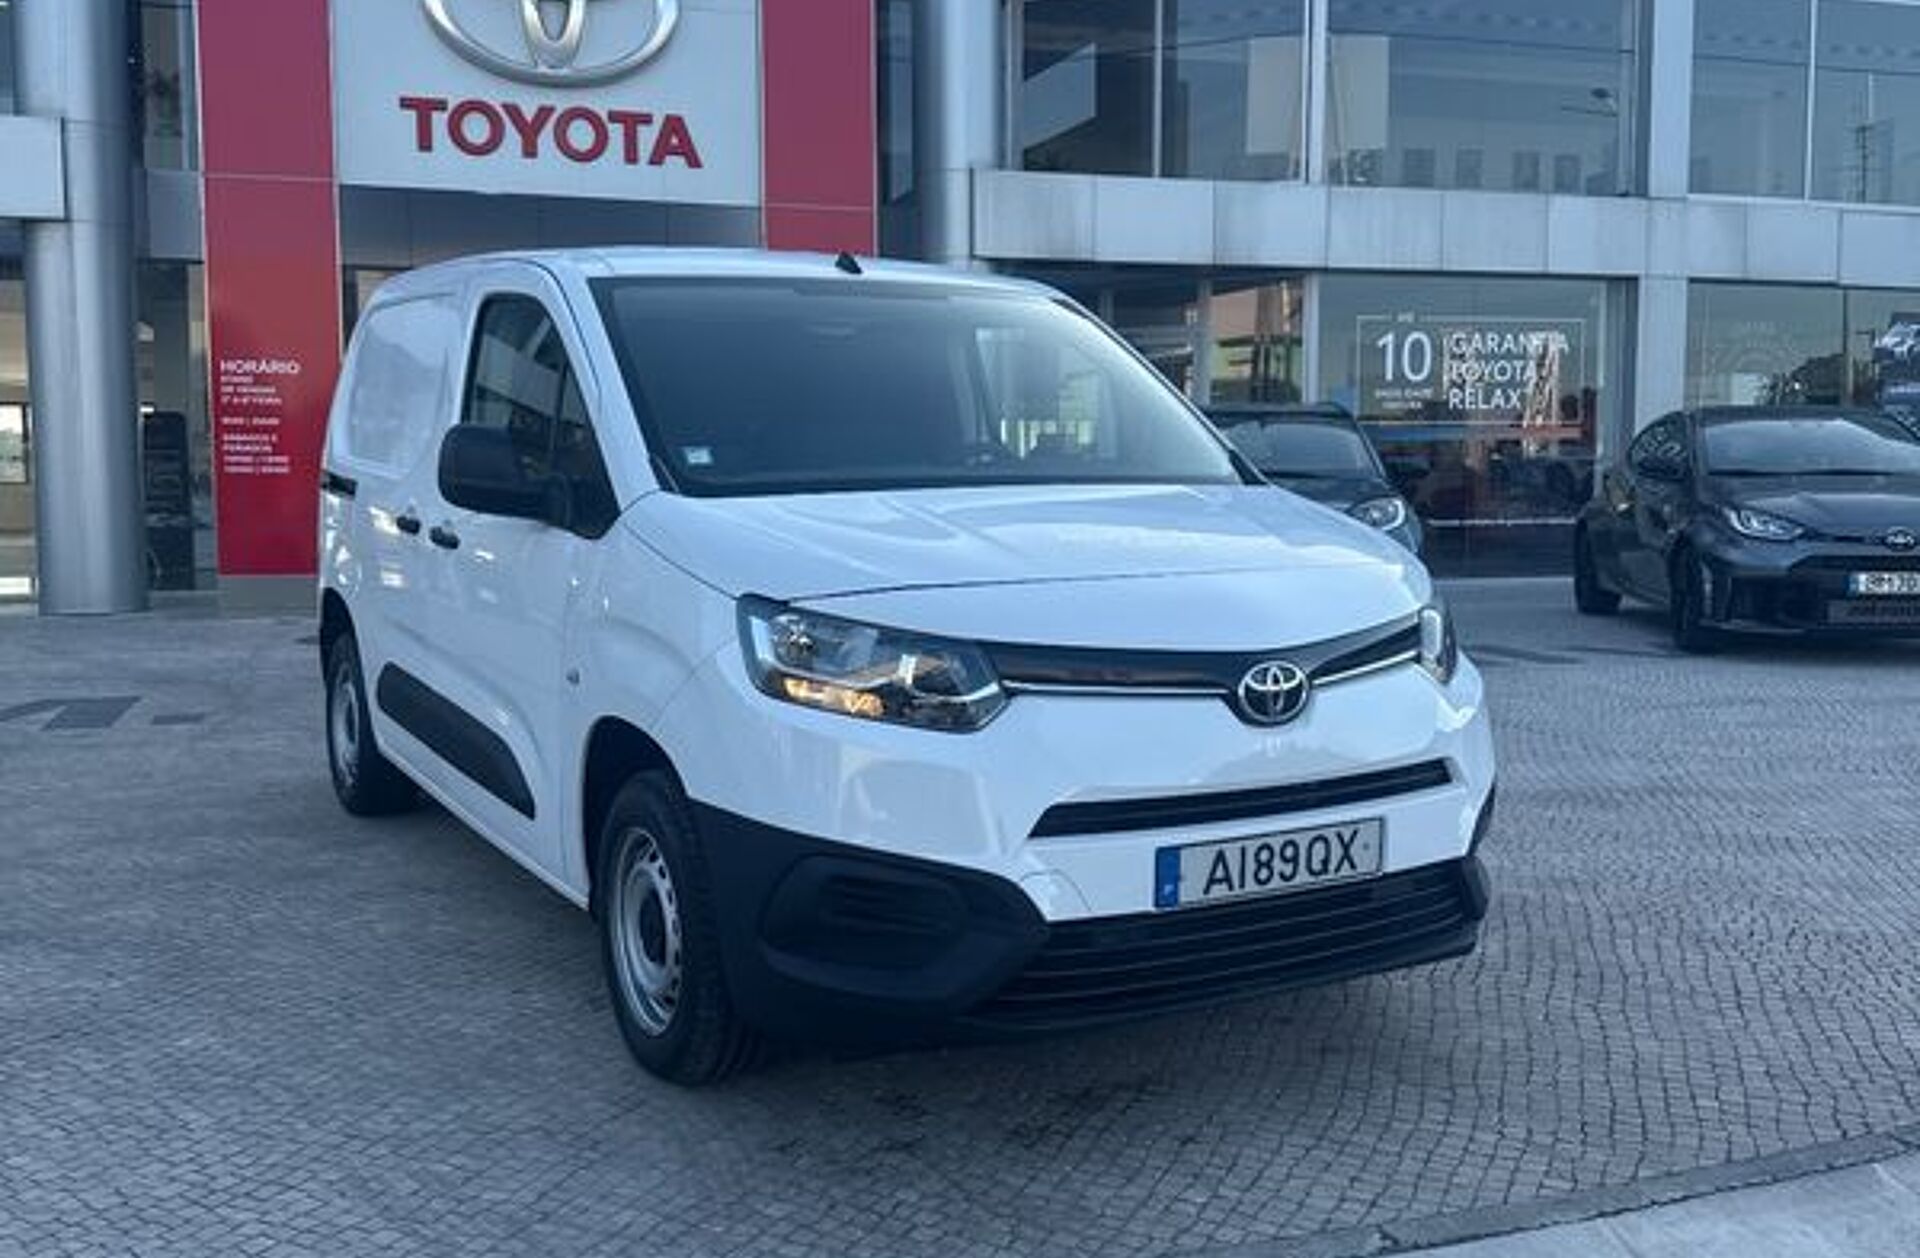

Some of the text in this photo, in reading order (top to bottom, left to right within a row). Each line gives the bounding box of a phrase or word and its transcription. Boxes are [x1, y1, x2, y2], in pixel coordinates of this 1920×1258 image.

[399, 96, 704, 168] TOYOTA
[1376, 331, 1432, 382] 10
[1449, 358, 1538, 383] TOYOTA
[1448, 387, 1522, 411] RELAX
[1203, 829, 1359, 895] AI89QX
